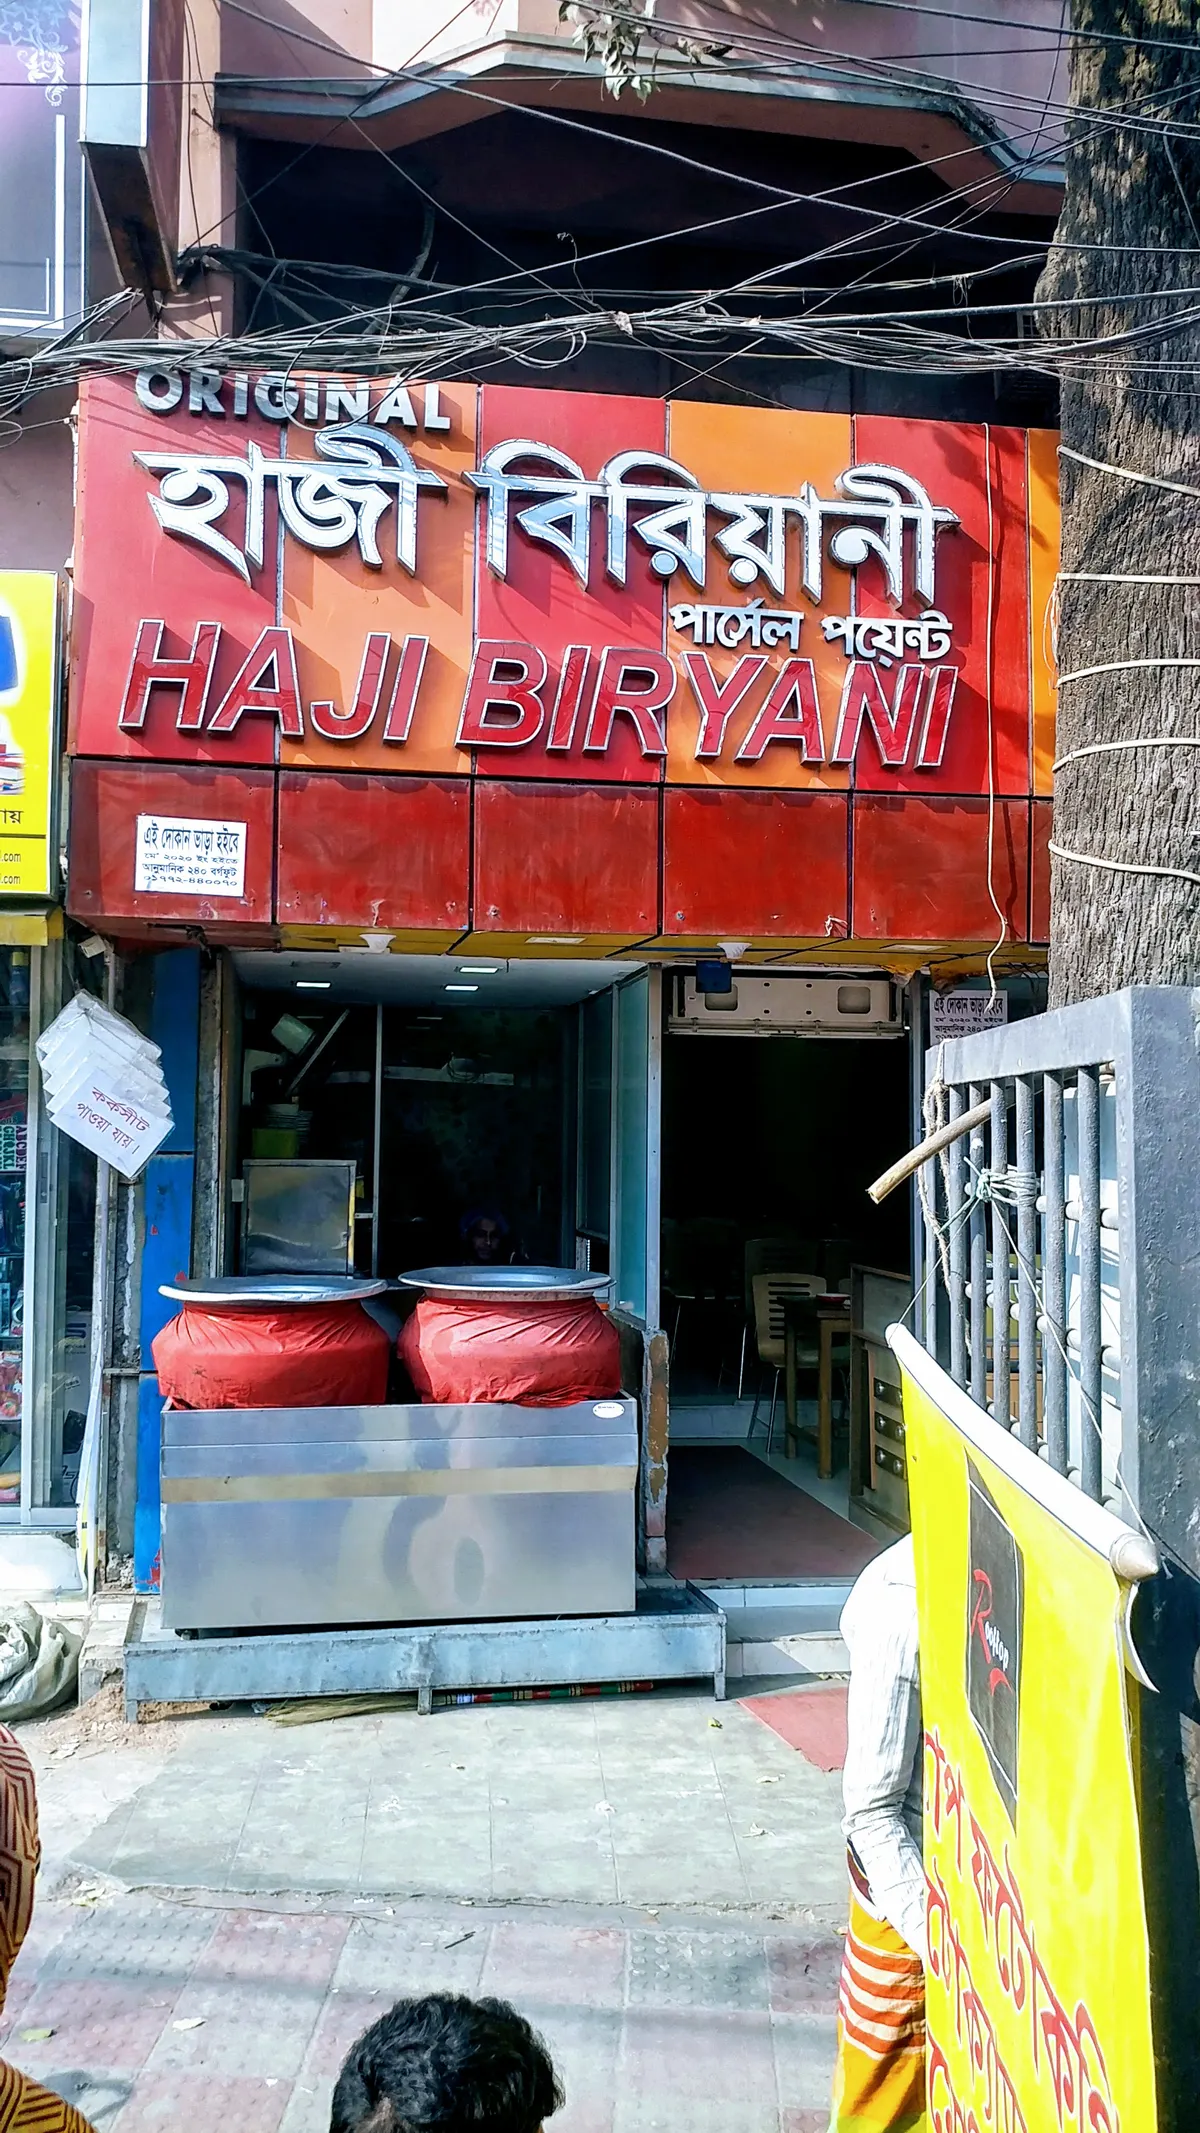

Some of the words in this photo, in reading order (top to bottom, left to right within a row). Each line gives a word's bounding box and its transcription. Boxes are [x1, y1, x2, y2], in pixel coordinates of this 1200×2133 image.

[135, 366, 451, 430] ORIGINAL
[133, 423, 449, 588] হাজী
[463, 438, 962, 609] বিরিয়ানী
[669, 598, 805, 652] পার্সেল
[820, 609, 954, 668] পয়েন্ট
[118, 618, 430, 746] HAJI
[455, 637, 959, 769] BIRYANI
[0, 808, 25, 825] ায়
[144, 820, 159, 849] এই
[161, 826, 192, 851] দোকান
[193, 827, 215, 856] ভাড়া
[216, 824, 240, 855] হইবে
[0, 850, 21, 862] .com
[142, 863, 184, 875] আনুমানিক
[187, 866, 208, 876] ২৪০
[210, 866, 238, 879] বর্গফুট
[164, 854, 192, 862] ২০২০
[0, 873, 21, 885] .com
[77, 1103, 113, 1133] পাওয়া
[970, 1568, 1010, 1673] Rooftop
